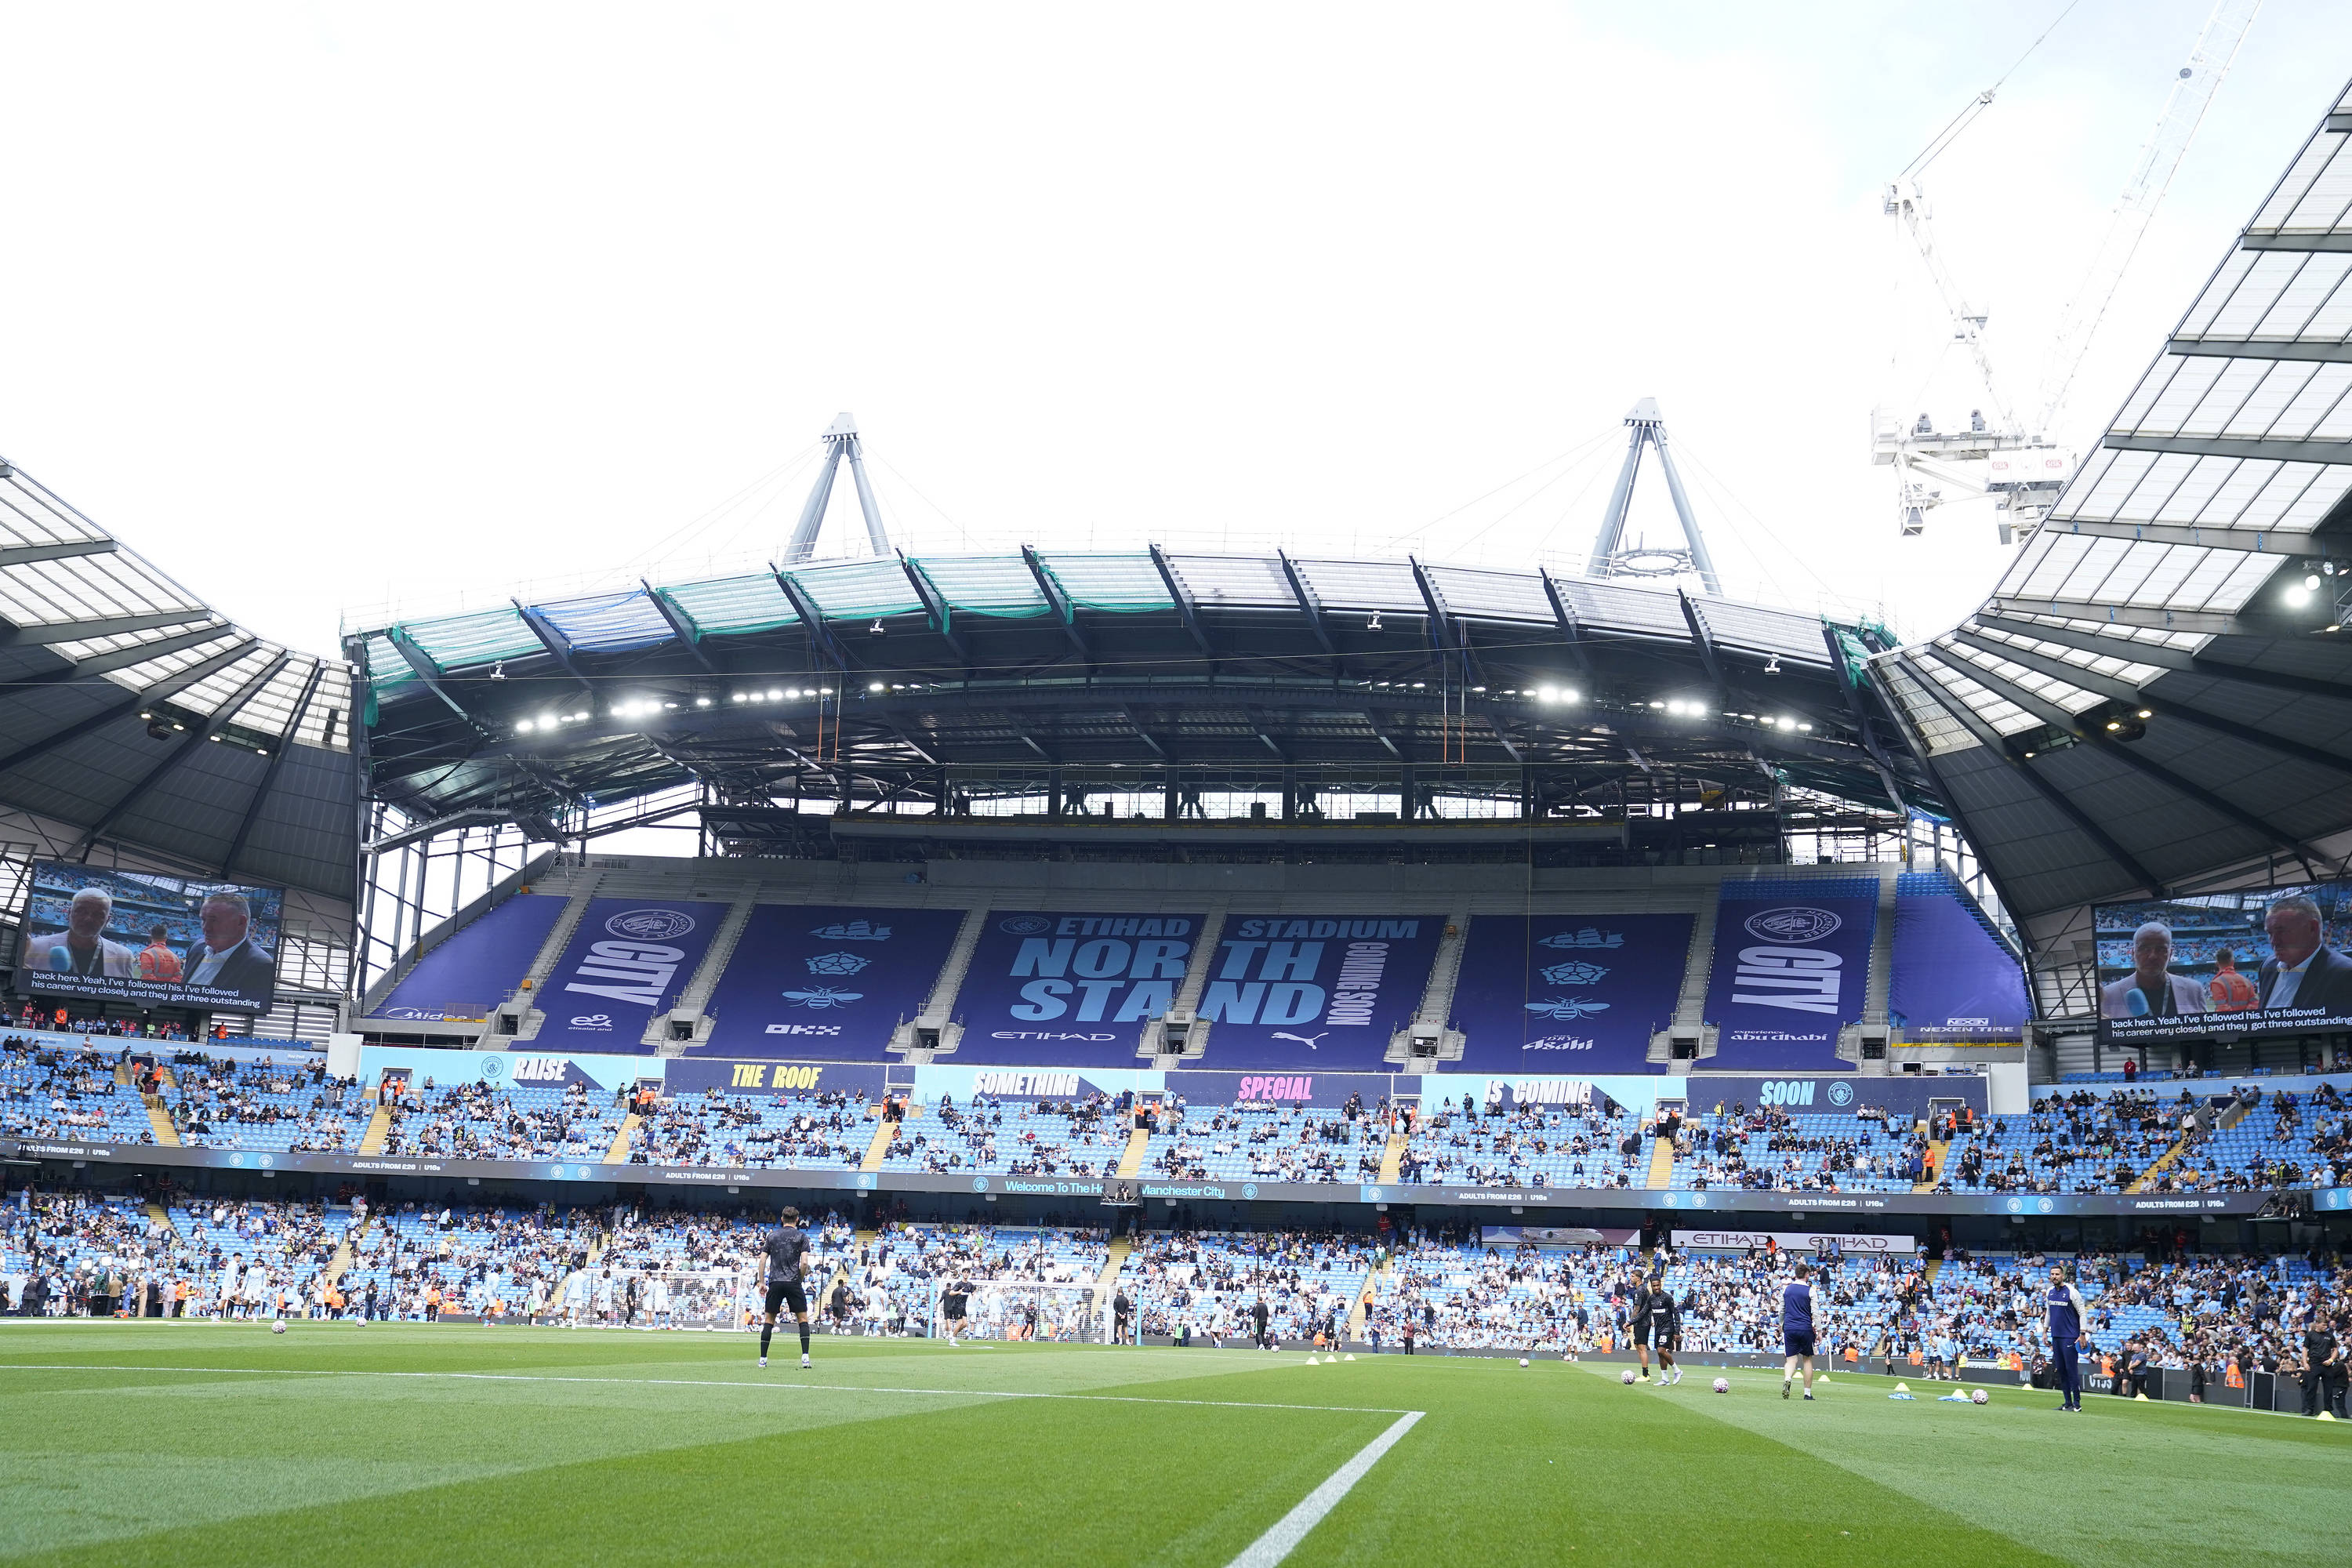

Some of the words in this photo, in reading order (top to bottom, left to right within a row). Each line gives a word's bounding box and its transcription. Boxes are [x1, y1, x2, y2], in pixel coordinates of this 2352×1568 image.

[1055, 916, 1191, 937] ETIHAD
[1238, 919, 1420, 939] STADIUM
[564, 940, 685, 1007] CITY
[1336, 942, 1390, 990] COMING
[33, 971, 56, 980] back
[57, 974, 80, 983] here.
[82, 975, 107, 986] Yeah,
[109, 978, 124, 987] I've
[128, 980, 167, 991] followed
[168, 983, 183, 992] his.
[185, 985, 200, 993] I've
[202, 987, 239, 997] followed
[1731, 946, 1843, 1014] CITY
[76, 986, 96, 995] very
[98, 987, 129, 997] closely
[148, 991, 168, 1000] they
[171, 993, 185, 1002] got
[187, 995, 209, 1003] three
[211, 996, 260, 1009] outstanding
[1325, 991, 1377, 1025] SOON
[2112, 1020, 2134, 1028] back
[2135, 1018, 2156, 1027] here.
[2158, 1016, 2183, 1025] Yeah,
[2184, 1015, 2200, 1024] I've
[2203, 1012, 2244, 1022] followed
[2246, 1011, 2263, 1020] his.
[2264, 1010, 2281, 1019] I've
[2282, 1006, 2326, 1018] followed
[2154, 1027, 2174, 1036] very
[2175, 1024, 2206, 1034] closely
[2208, 1023, 2225, 1032] and
[2226, 1023, 2248, 1032] they
[2251, 1021, 2266, 1031] got
[2268, 1019, 2293, 1028] three
[2295, 1016, 2352, 1027] outstanding
[765, 1024, 842, 1035] OKX
[991, 1031, 1116, 1041] ETIHAD
[1522, 1039, 1594, 1050] Asahi
[512, 1057, 571, 1081] RAISE
[731, 1064, 767, 1087] THE
[771, 1066, 823, 1090] ROOF
[972, 1071, 1080, 1096] SOMETHING
[1238, 1076, 1313, 1100] SPECIAL
[1483, 1079, 1505, 1103] IS
[1512, 1080, 1593, 1104] COMING
[1759, 1081, 1815, 1105] SOON
[1005, 1181, 1055, 1193] Welcome
[1056, 1182, 1068, 1193] To
[1070, 1182, 1089, 1194] The
[1142, 1184, 1202, 1197] Manchester
[1203, 1185, 1225, 1199] City
[1693, 1233, 1768, 1246] ETIHAD
[1809, 1236, 1888, 1248] ETIHAD
